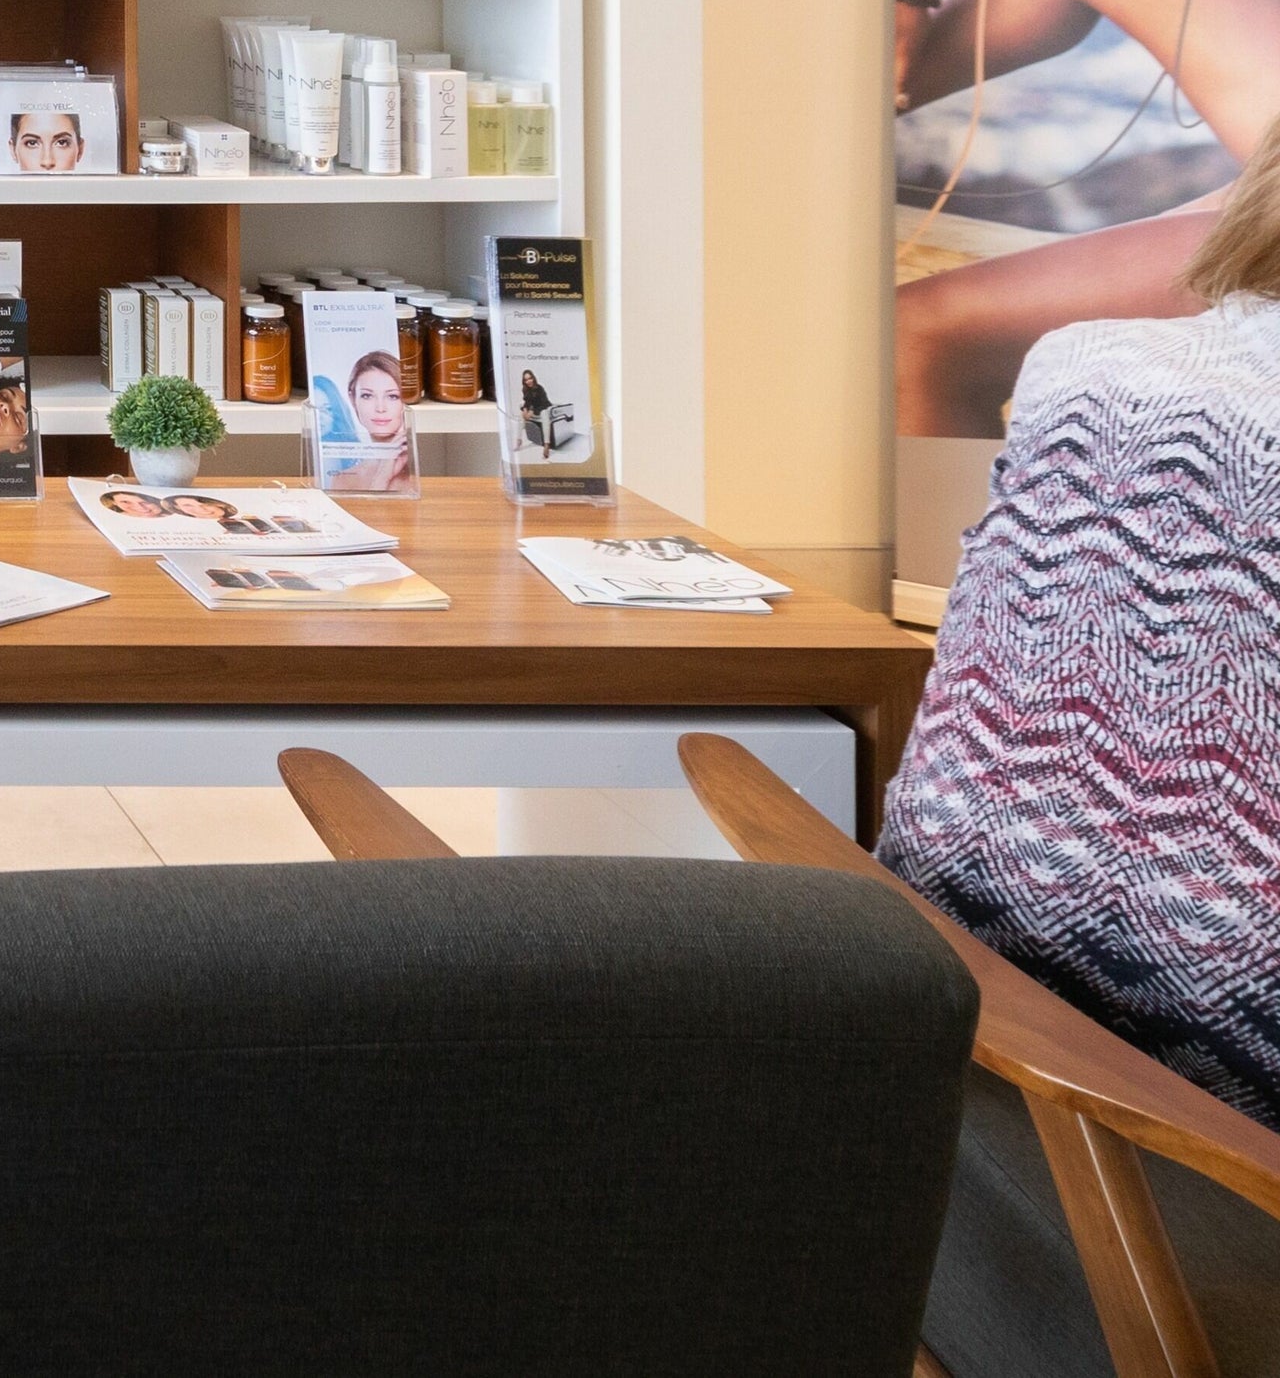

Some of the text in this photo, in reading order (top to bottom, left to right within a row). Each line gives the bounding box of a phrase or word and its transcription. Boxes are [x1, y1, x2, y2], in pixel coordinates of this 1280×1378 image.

[19, 102, 51, 111] TROUSSE
[510, 272, 539, 281] Solution
[553, 291, 583, 301] Sexuelle
[513, 310, 552, 319] Retrouvez
[0, 330, 15, 338] pour
[0, 338, 15, 347] peau
